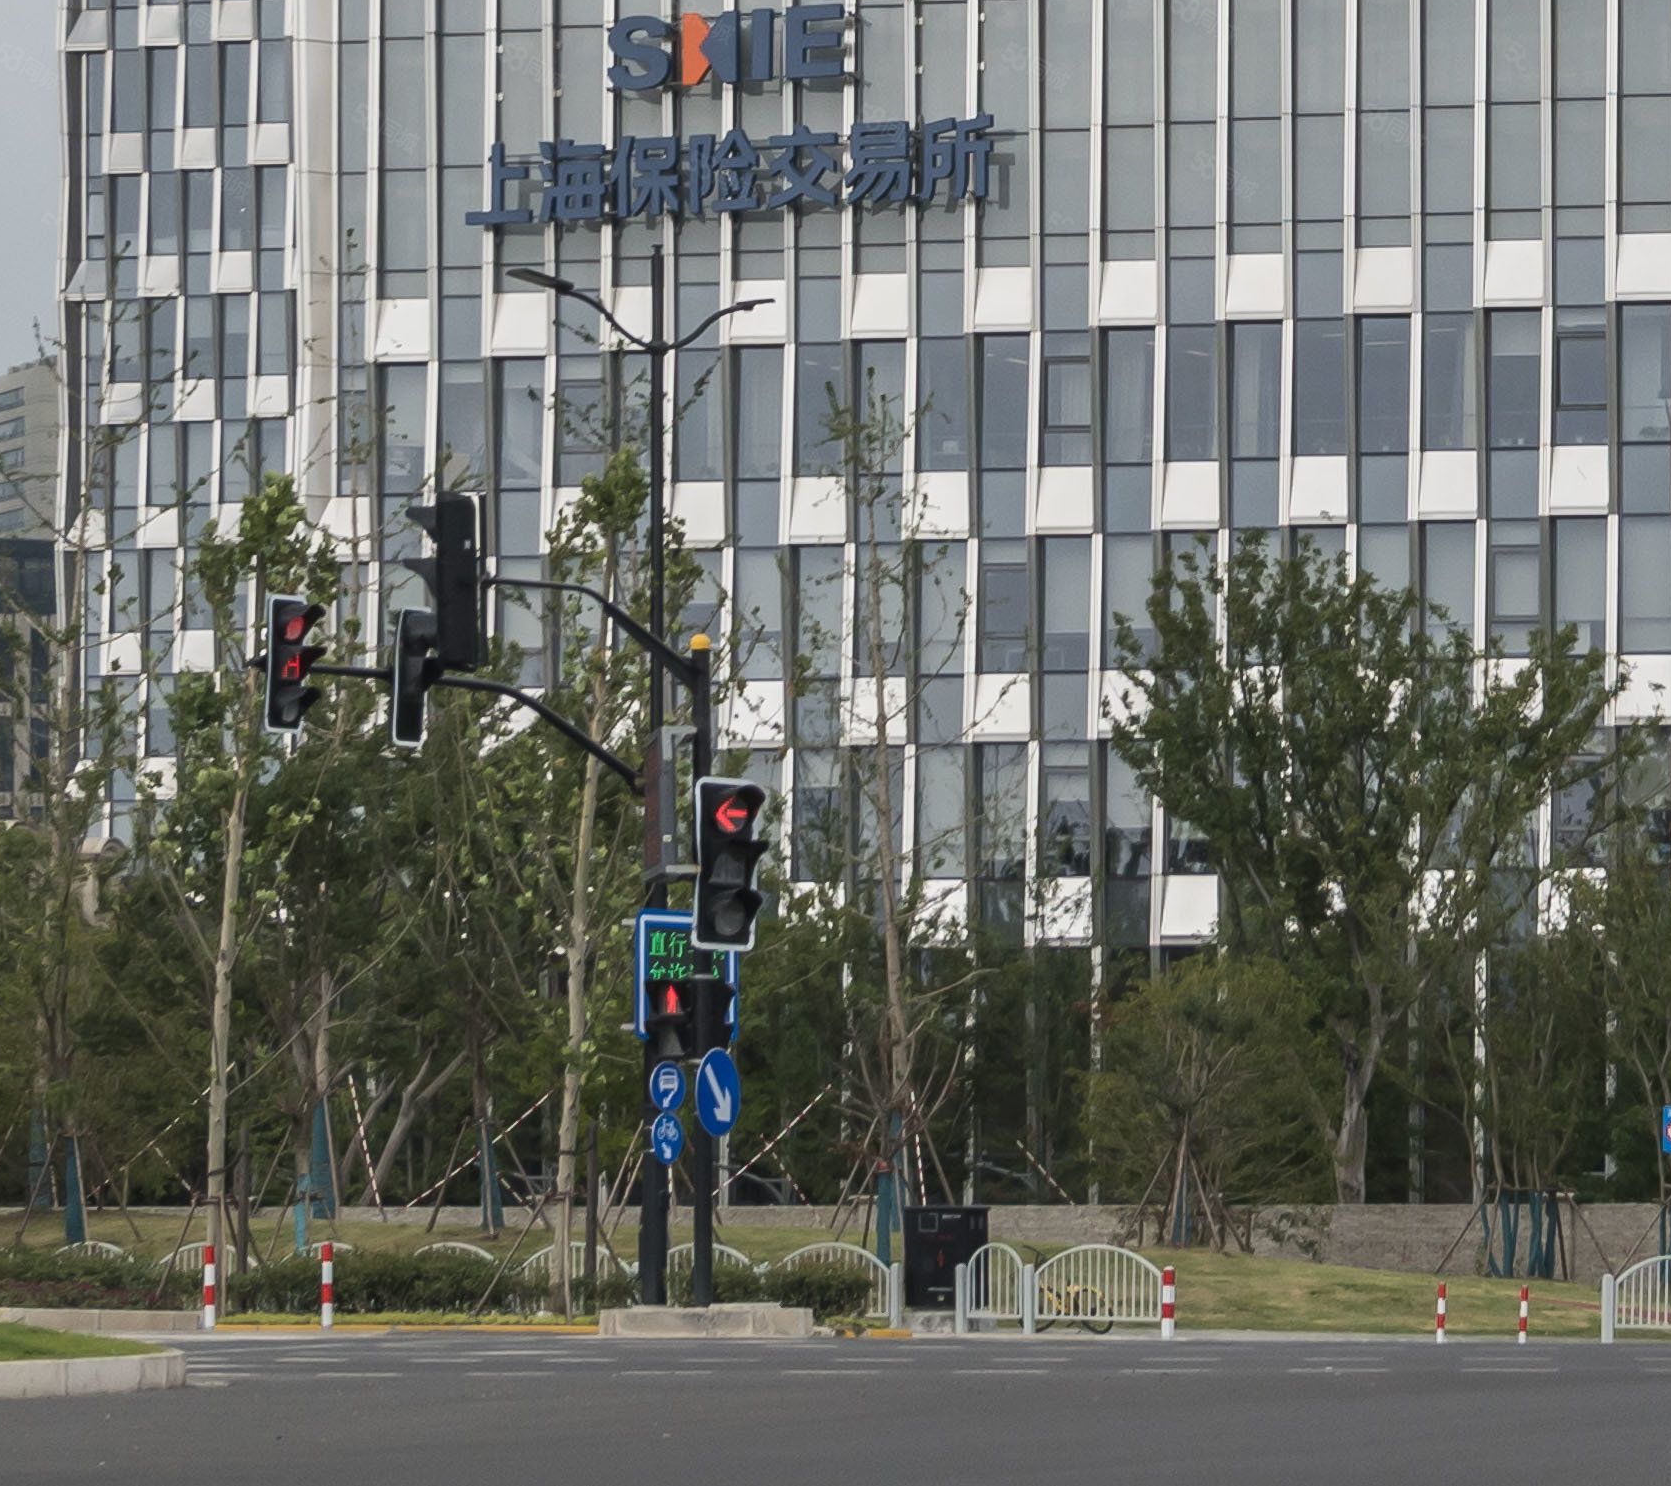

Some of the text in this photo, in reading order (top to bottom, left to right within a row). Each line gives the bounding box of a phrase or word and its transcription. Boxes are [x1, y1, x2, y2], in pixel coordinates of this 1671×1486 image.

[465, 114, 996, 226] 上海保险交易所
